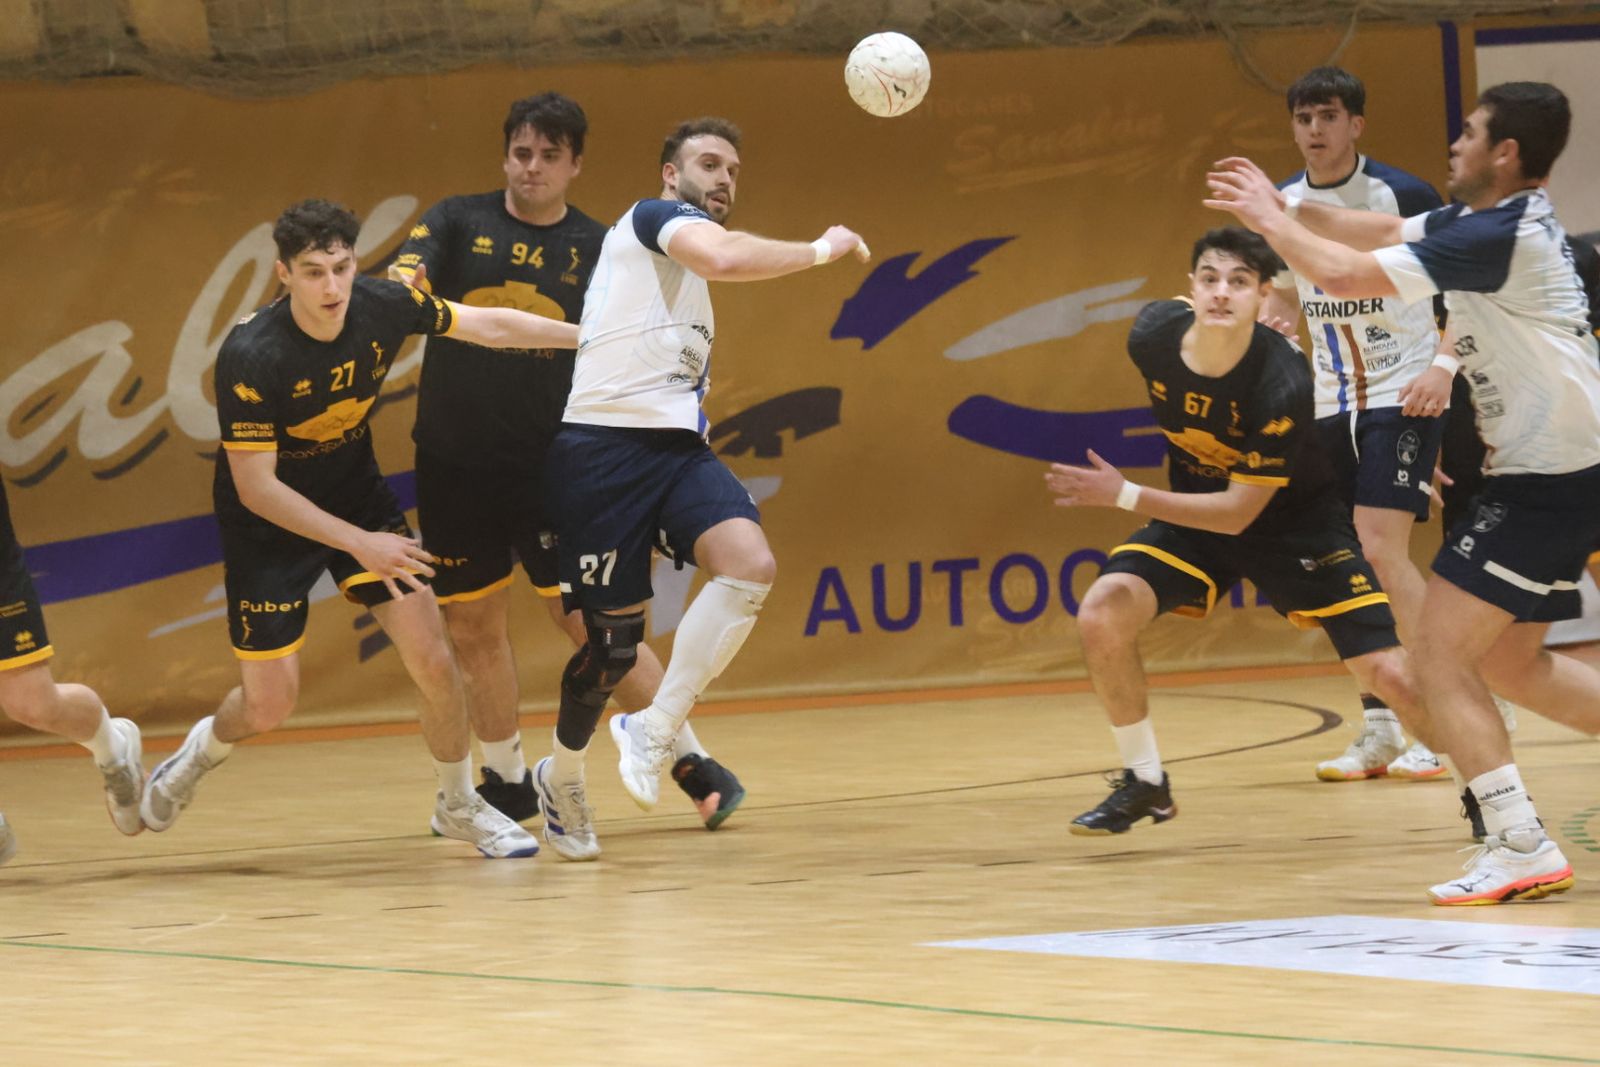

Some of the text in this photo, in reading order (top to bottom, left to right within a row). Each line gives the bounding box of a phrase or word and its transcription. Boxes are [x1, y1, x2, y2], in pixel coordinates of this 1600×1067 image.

[511, 242, 545, 269] 94
[330, 360, 355, 392] 27
[1184, 391, 1212, 418] 67
[579, 548, 617, 586] 27
